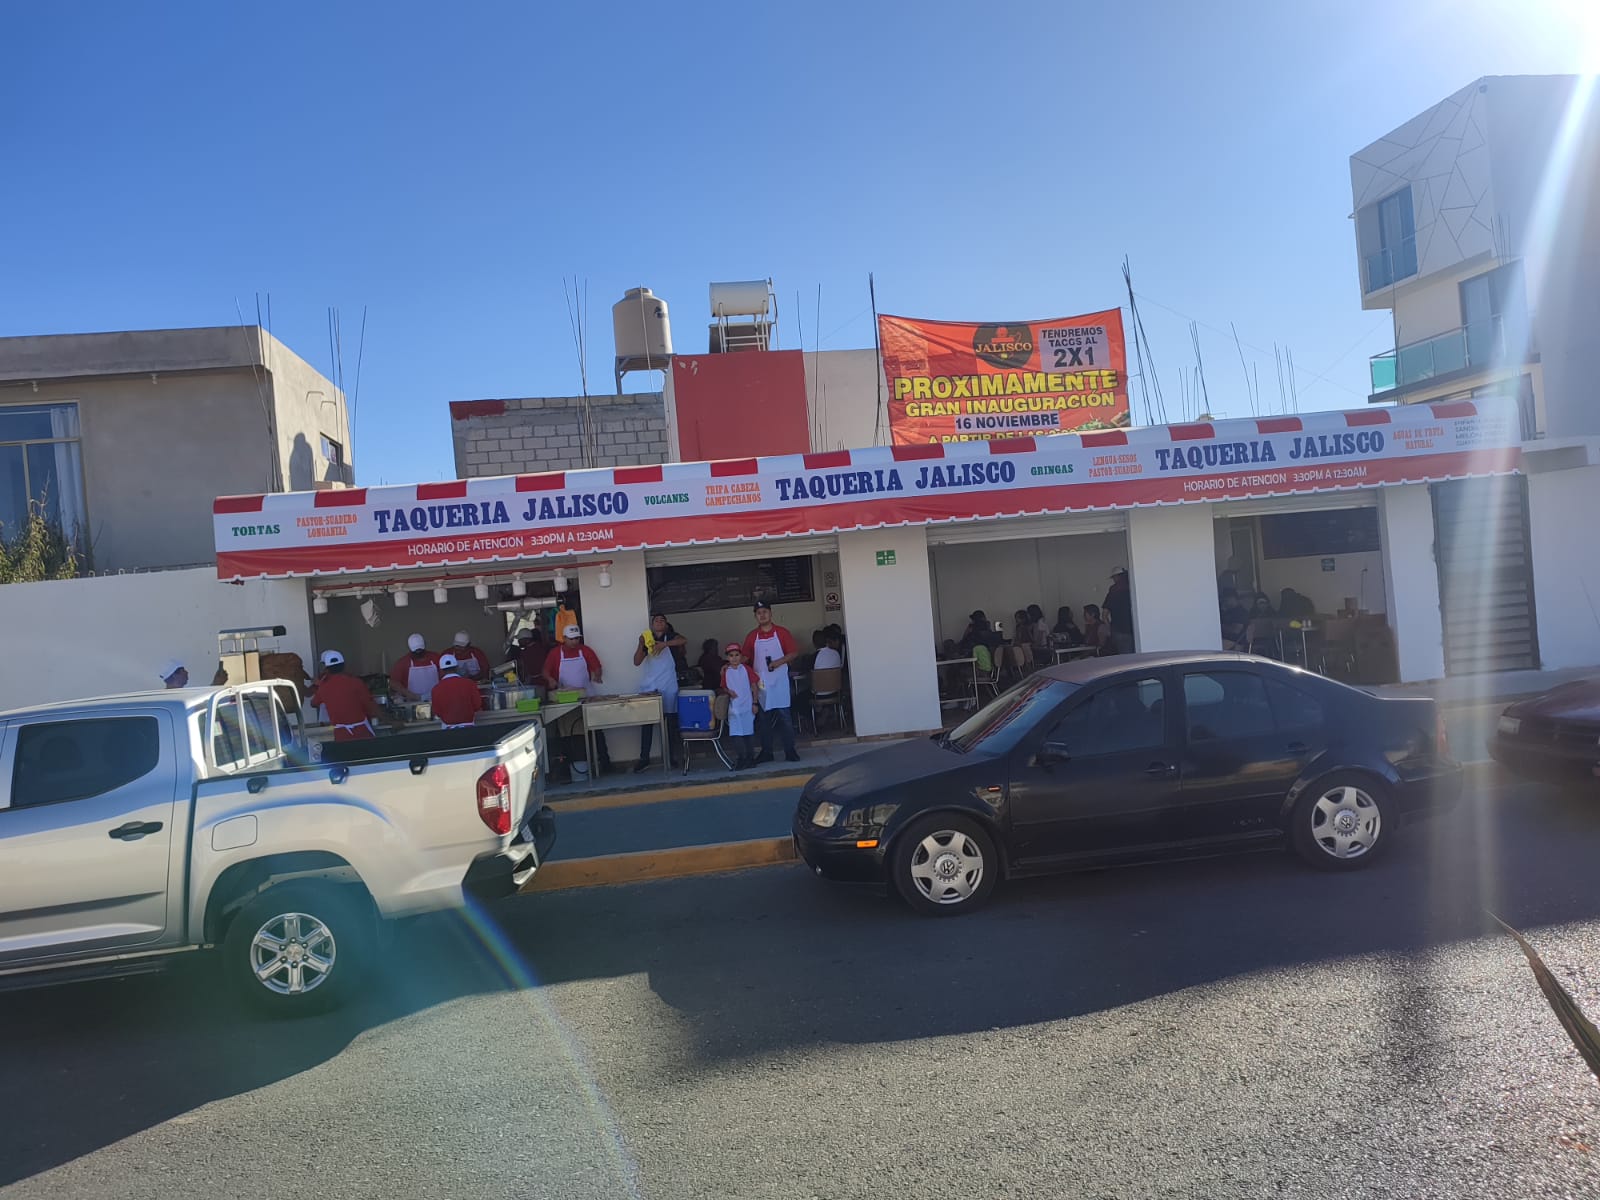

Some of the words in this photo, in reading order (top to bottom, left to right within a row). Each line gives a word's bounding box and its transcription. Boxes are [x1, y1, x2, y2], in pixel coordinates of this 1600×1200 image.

[1042, 326, 1103, 339] TENDREMOS
[975, 342, 1033, 353] JALISCO
[1085, 336, 1098, 345] AL
[1053, 346, 1095, 368] 2X1
[893, 369, 1119, 401] PROXIMAMENTE
[905, 401, 962, 418] GRAN
[966, 390, 1116, 415] INAUGURACIÓN
[956, 417, 972, 430] 16
[976, 413, 1059, 429] NOVIEMBRE
[1155, 440, 1276, 471] TAQUERIA
[1289, 430, 1385, 459] JALISCO
[1030, 464, 1074, 476] GRINGAS
[775, 468, 904, 501] TAQUERIA
[915, 460, 1016, 489] JALISCO
[1183, 479, 1225, 492] HORARIO
[1227, 477, 1239, 488] DE
[1241, 473, 1287, 487] ATENCION
[1325, 468, 1333, 479] A
[705, 484, 729, 495] TRIPA
[730, 482, 760, 493] CABEZA
[643, 493, 690, 506] VOLCANES
[705, 493, 762, 507] CAMPECHANOS
[373, 500, 510, 534] TAQUERIA
[522, 491, 629, 521] JALISCO
[296, 513, 358, 528] PASTOR-SUADERO
[231, 524, 281, 537] TORTAS
[307, 526, 348, 539] LONGANIZA
[408, 541, 455, 556] HORARIO
[457, 539, 470, 552] DE
[472, 536, 524, 551] ATENCION
[531, 532, 565, 546] 3:30PM
[567, 531, 575, 543] A
[576, 529, 614, 542] 12:30AM
